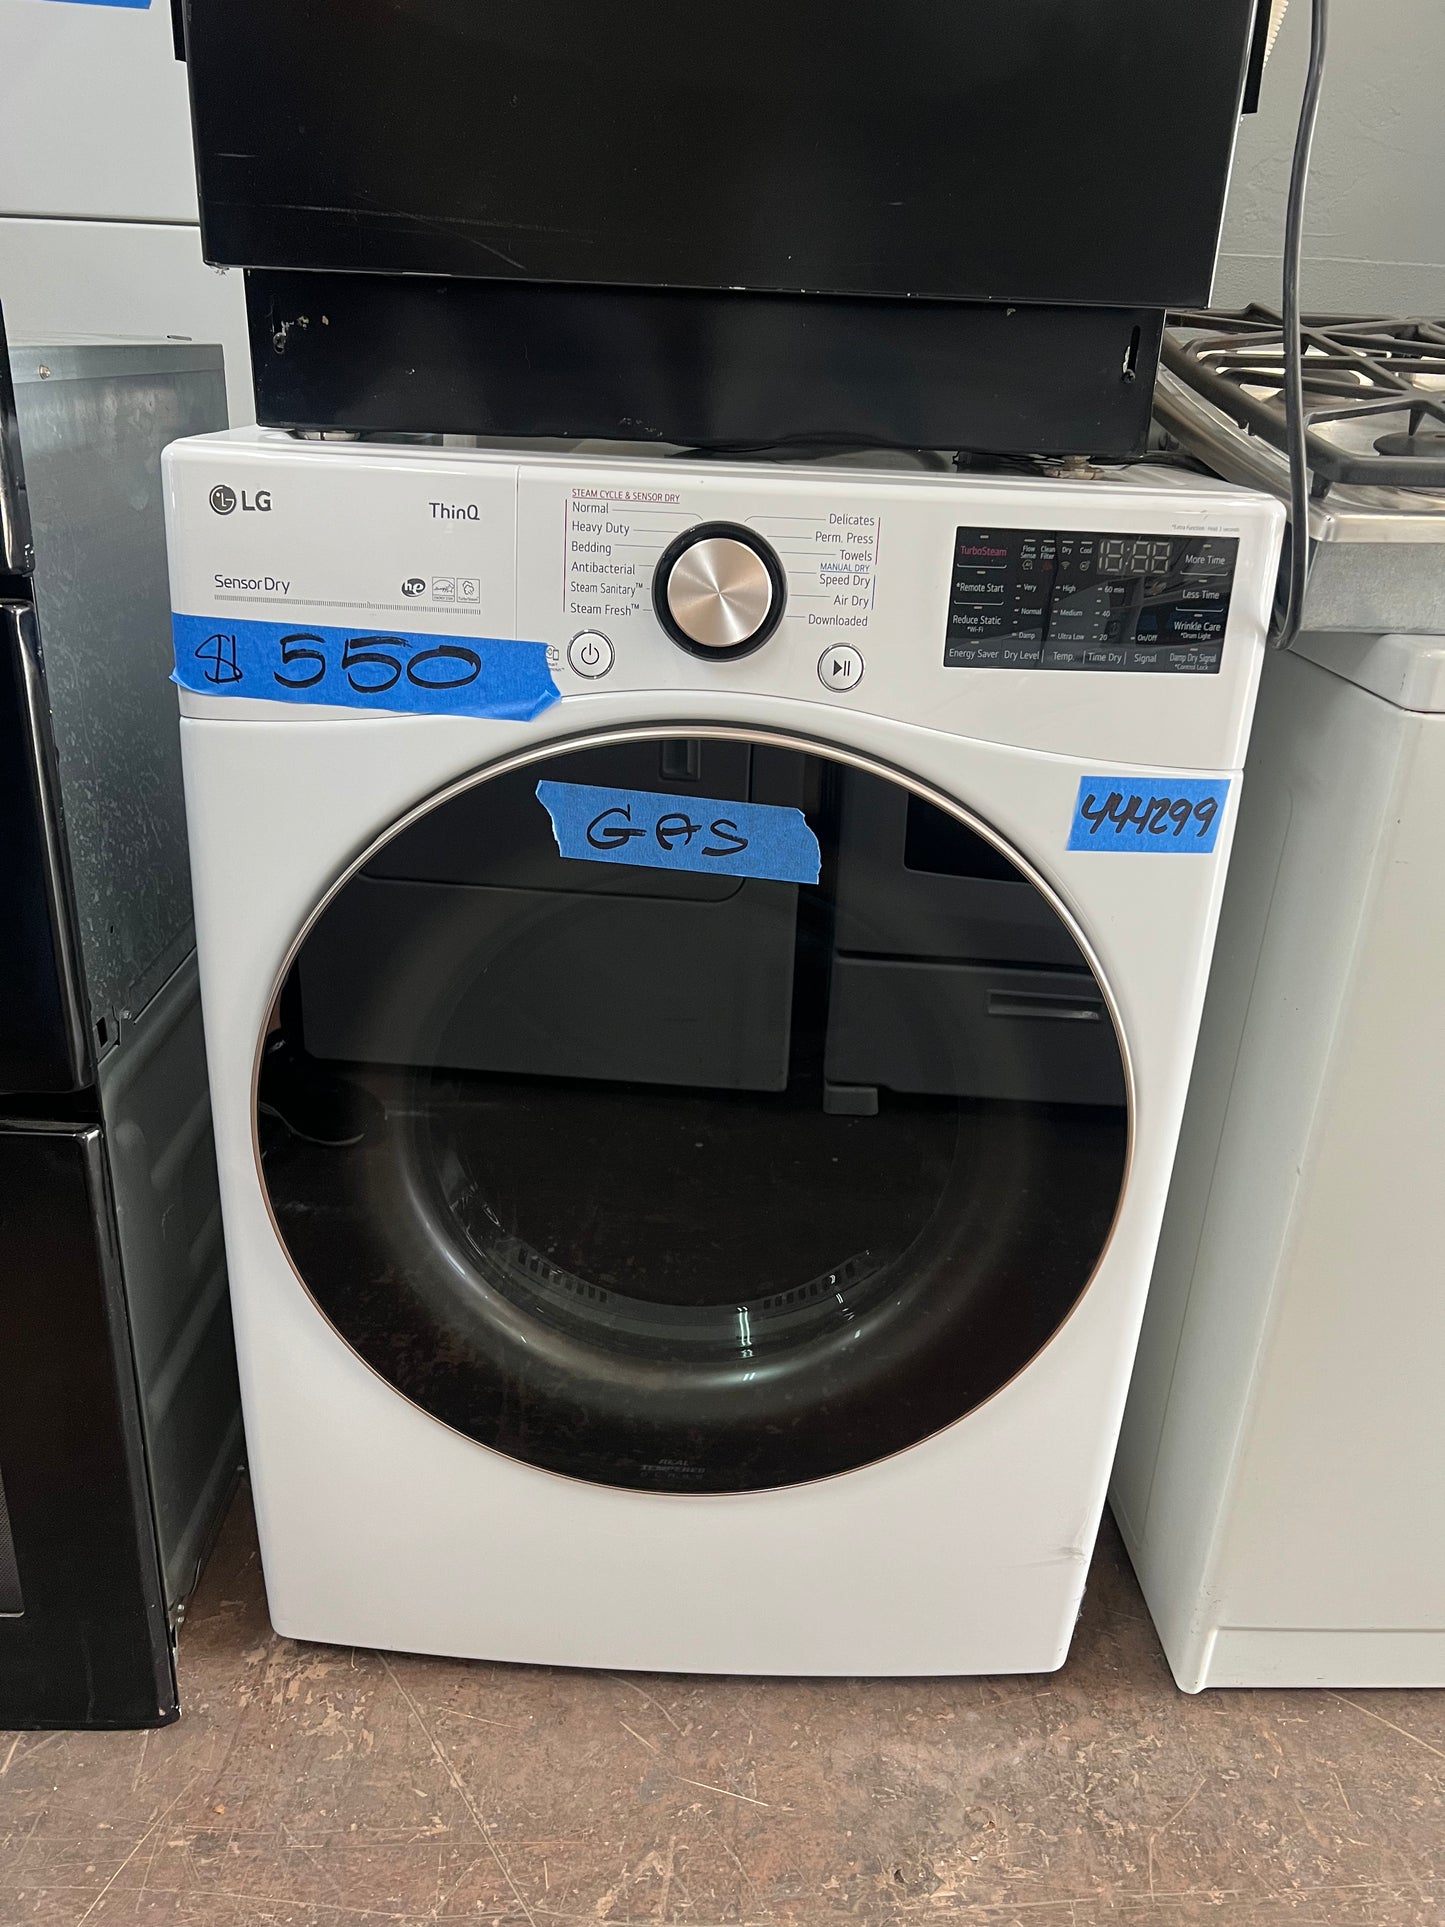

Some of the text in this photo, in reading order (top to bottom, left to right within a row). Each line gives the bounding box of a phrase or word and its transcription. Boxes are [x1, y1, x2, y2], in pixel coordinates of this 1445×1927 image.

[241, 490, 272, 511] LG
[572, 488, 681, 503] STEAM CYCLE & SENSOR DRY
[429, 502, 480, 520] ThinQ
[572, 501, 609, 514] Normal
[829, 513, 875, 527] Delicates
[572, 520, 630, 537] Heavy Duty
[815, 530, 874, 545] Perm. Press
[571, 540, 612, 557] Bedding
[960, 545, 1008, 557] TurboSteam
[1022, 545, 1036, 553] Flow
[1040, 545, 1056, 553] Clean
[1061, 546, 1072, 555] Dry
[840, 549, 873, 562] Towels
[1185, 554, 1226, 566] More Time
[571, 561, 636, 575] Antibacterial
[820, 562, 871, 573] MANUAL DRY
[570, 581, 598, 593] Steam
[819, 573, 871, 590] Speed Dry
[986, 583, 1005, 593] Start
[1023, 583, 1037, 593] Very
[1062, 585, 1077, 595] High
[1104, 586, 1114, 594] 60
[1182, 589, 1220, 601] Less Time
[833, 594, 869, 610] Air Dry
[570, 602, 602, 615] Steam
[1021, 608, 1042, 616] Normal
[1059, 608, 1083, 617] Medium
[1101, 610, 1111, 618] 40
[808, 613, 869, 628] Downloaded
[952, 614, 1002, 626] Reduce Static
[1173, 621, 1222, 633] Wrinkle Care
[1018, 631, 1036, 641] Damp
[1057, 632, 1085, 641] Ultra Low
[1137, 633, 1158, 643] On/Off
[949, 648, 999, 661] Energy Saver
[1004, 649, 1041, 662] Dry Level
[1053, 651, 1075, 663] Temp.
[1088, 652, 1122, 665] Time Dry
[1134, 653, 1157, 665] Signal
[1169, 653, 1217, 665] Damp Dry Signal
[194, 632, 482, 694] $ 550
[1081, 791, 1219, 838] 444299
[586, 803, 749, 857] GAS
